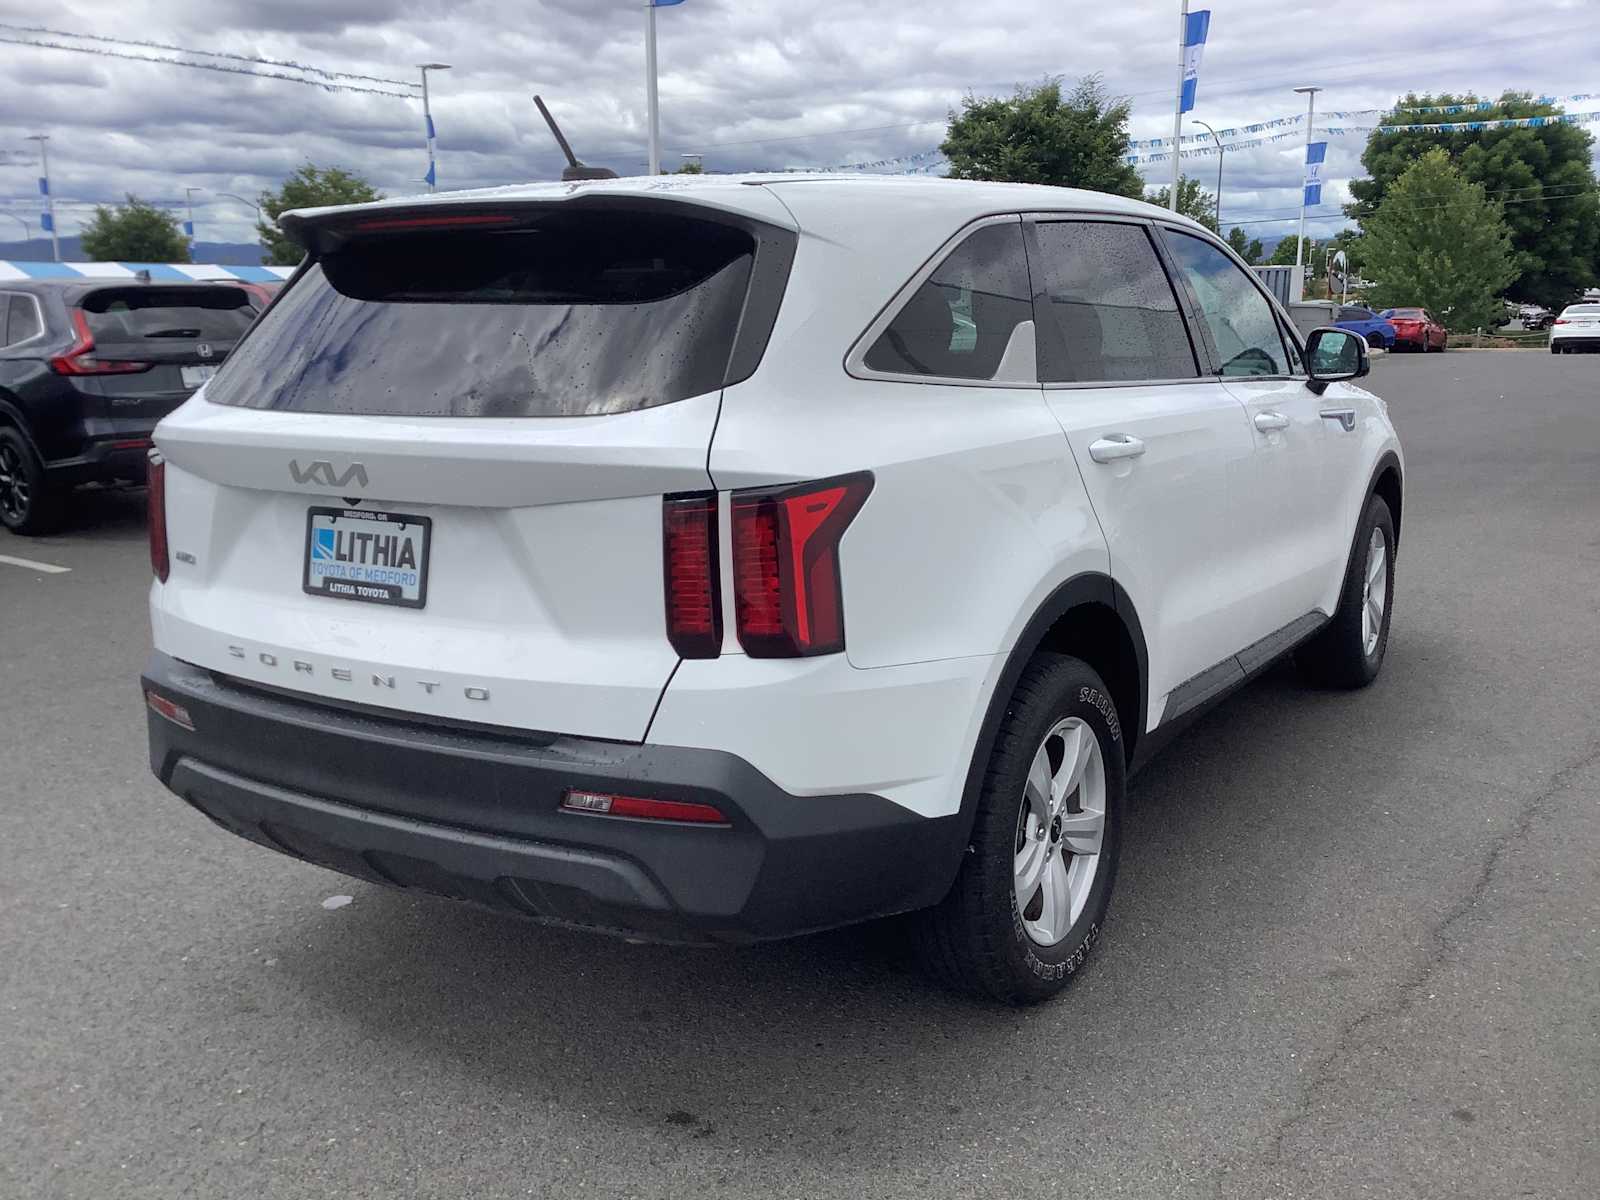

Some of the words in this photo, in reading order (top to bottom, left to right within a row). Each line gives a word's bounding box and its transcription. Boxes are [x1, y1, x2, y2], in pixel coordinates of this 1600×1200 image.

[289, 460, 368, 488] KIA
[336, 530, 416, 570] LITHIA
[312, 562, 346, 577] TOYOTA
[350, 567, 361, 578] OF
[365, 568, 416, 587] MEDFORD
[329, 582, 355, 594] LITHIA
[357, 586, 389, 599] TOYOTA
[228, 645, 490, 701] SORENTO
